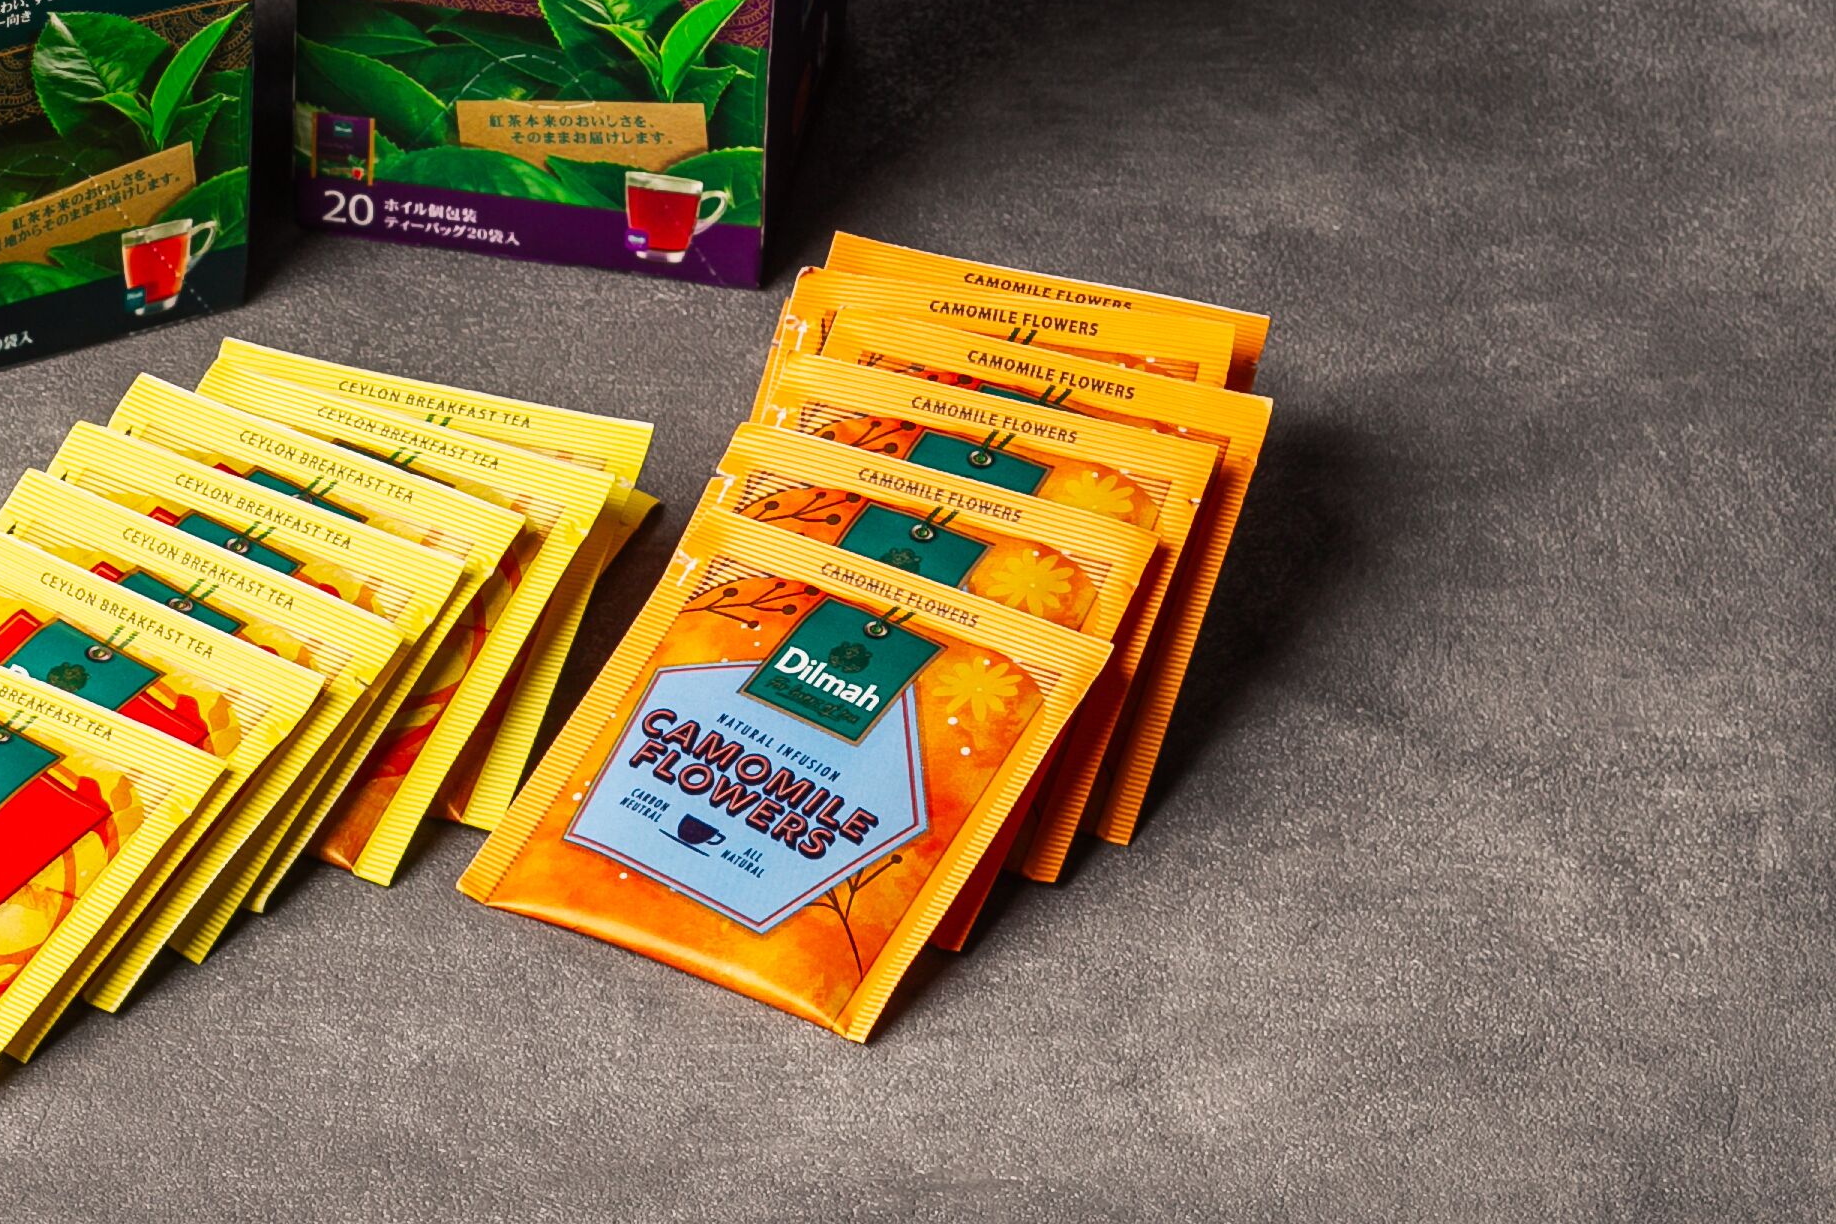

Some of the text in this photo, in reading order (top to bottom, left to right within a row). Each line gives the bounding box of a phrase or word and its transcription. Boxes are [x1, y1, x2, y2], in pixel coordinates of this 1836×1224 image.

[510, 129, 674, 147] そのままお届けします。
[322, 190, 375, 226] 20
[383, 197, 478, 223] ホイル個包装
[964, 272, 1052, 299] CAMOMILE
[929, 300, 1099, 337] CAMOMILE FLOWERS
[967, 349, 1136, 400] CAMOMILE FLOWERS
[337, 379, 532, 430] CEYLON BREAKFAST TEA
[911, 396, 1078, 444] CAMOMILE FLOWERS
[317, 405, 500, 471] CEYLON BREAKFAST TEA
[239, 429, 414, 505] CEYLON BREAKFAST TEA
[174, 473, 352, 551] CEYLON BREAKFAST TEA
[858, 467, 1023, 523] CAMOMILE FLOWERS
[121, 527, 295, 612] CEYLON BREAKFAST TEA
[820, 561, 981, 628] CAMOMILE FLOWERS
[39, 571, 215, 661] CEYLON BREAKFAST TEA
[774, 646, 880, 712] Dilmah
[83, 719, 114, 742] TEA
[716, 712, 841, 783] NATURAL INFUSION
[628, 738, 837, 861] FLOWERS
[630, 787, 671, 812] CARBON
[641, 707, 880, 847] CAMOMILE
[619, 796, 663, 824] NEUTRAL
[720, 848, 765, 880] NATURAL
[742, 846, 764, 863] ALL
